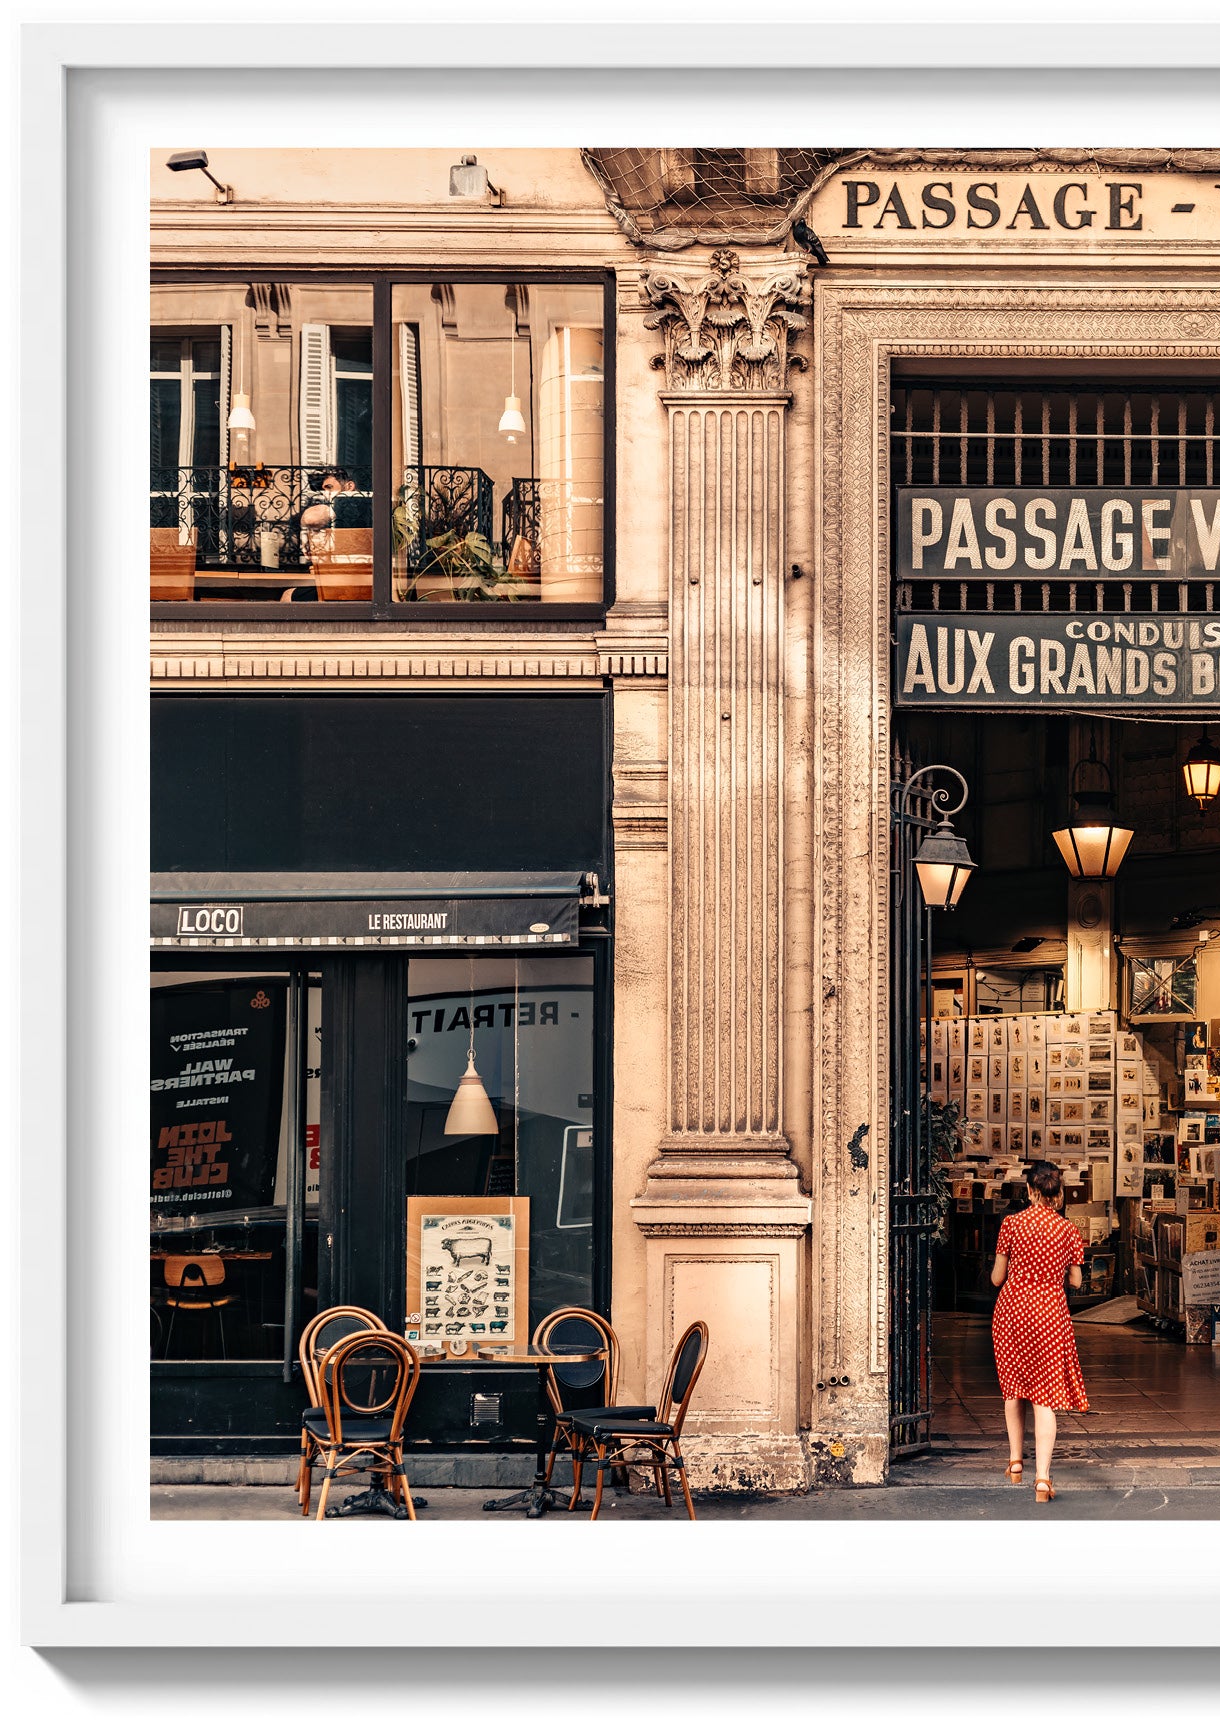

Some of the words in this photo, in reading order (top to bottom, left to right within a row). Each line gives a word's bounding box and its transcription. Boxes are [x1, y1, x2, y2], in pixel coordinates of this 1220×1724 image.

[841, 180, 1145, 232] PASSAGE
[910, 497, 1172, 572] PASSAGE
[902, 623, 995, 695] AUX
[1008, 642, 1178, 695] GRANDS
[181, 908, 240, 934] LOCO
[368, 915, 382, 931] LE
[384, 913, 448, 930] RESTAURANT
